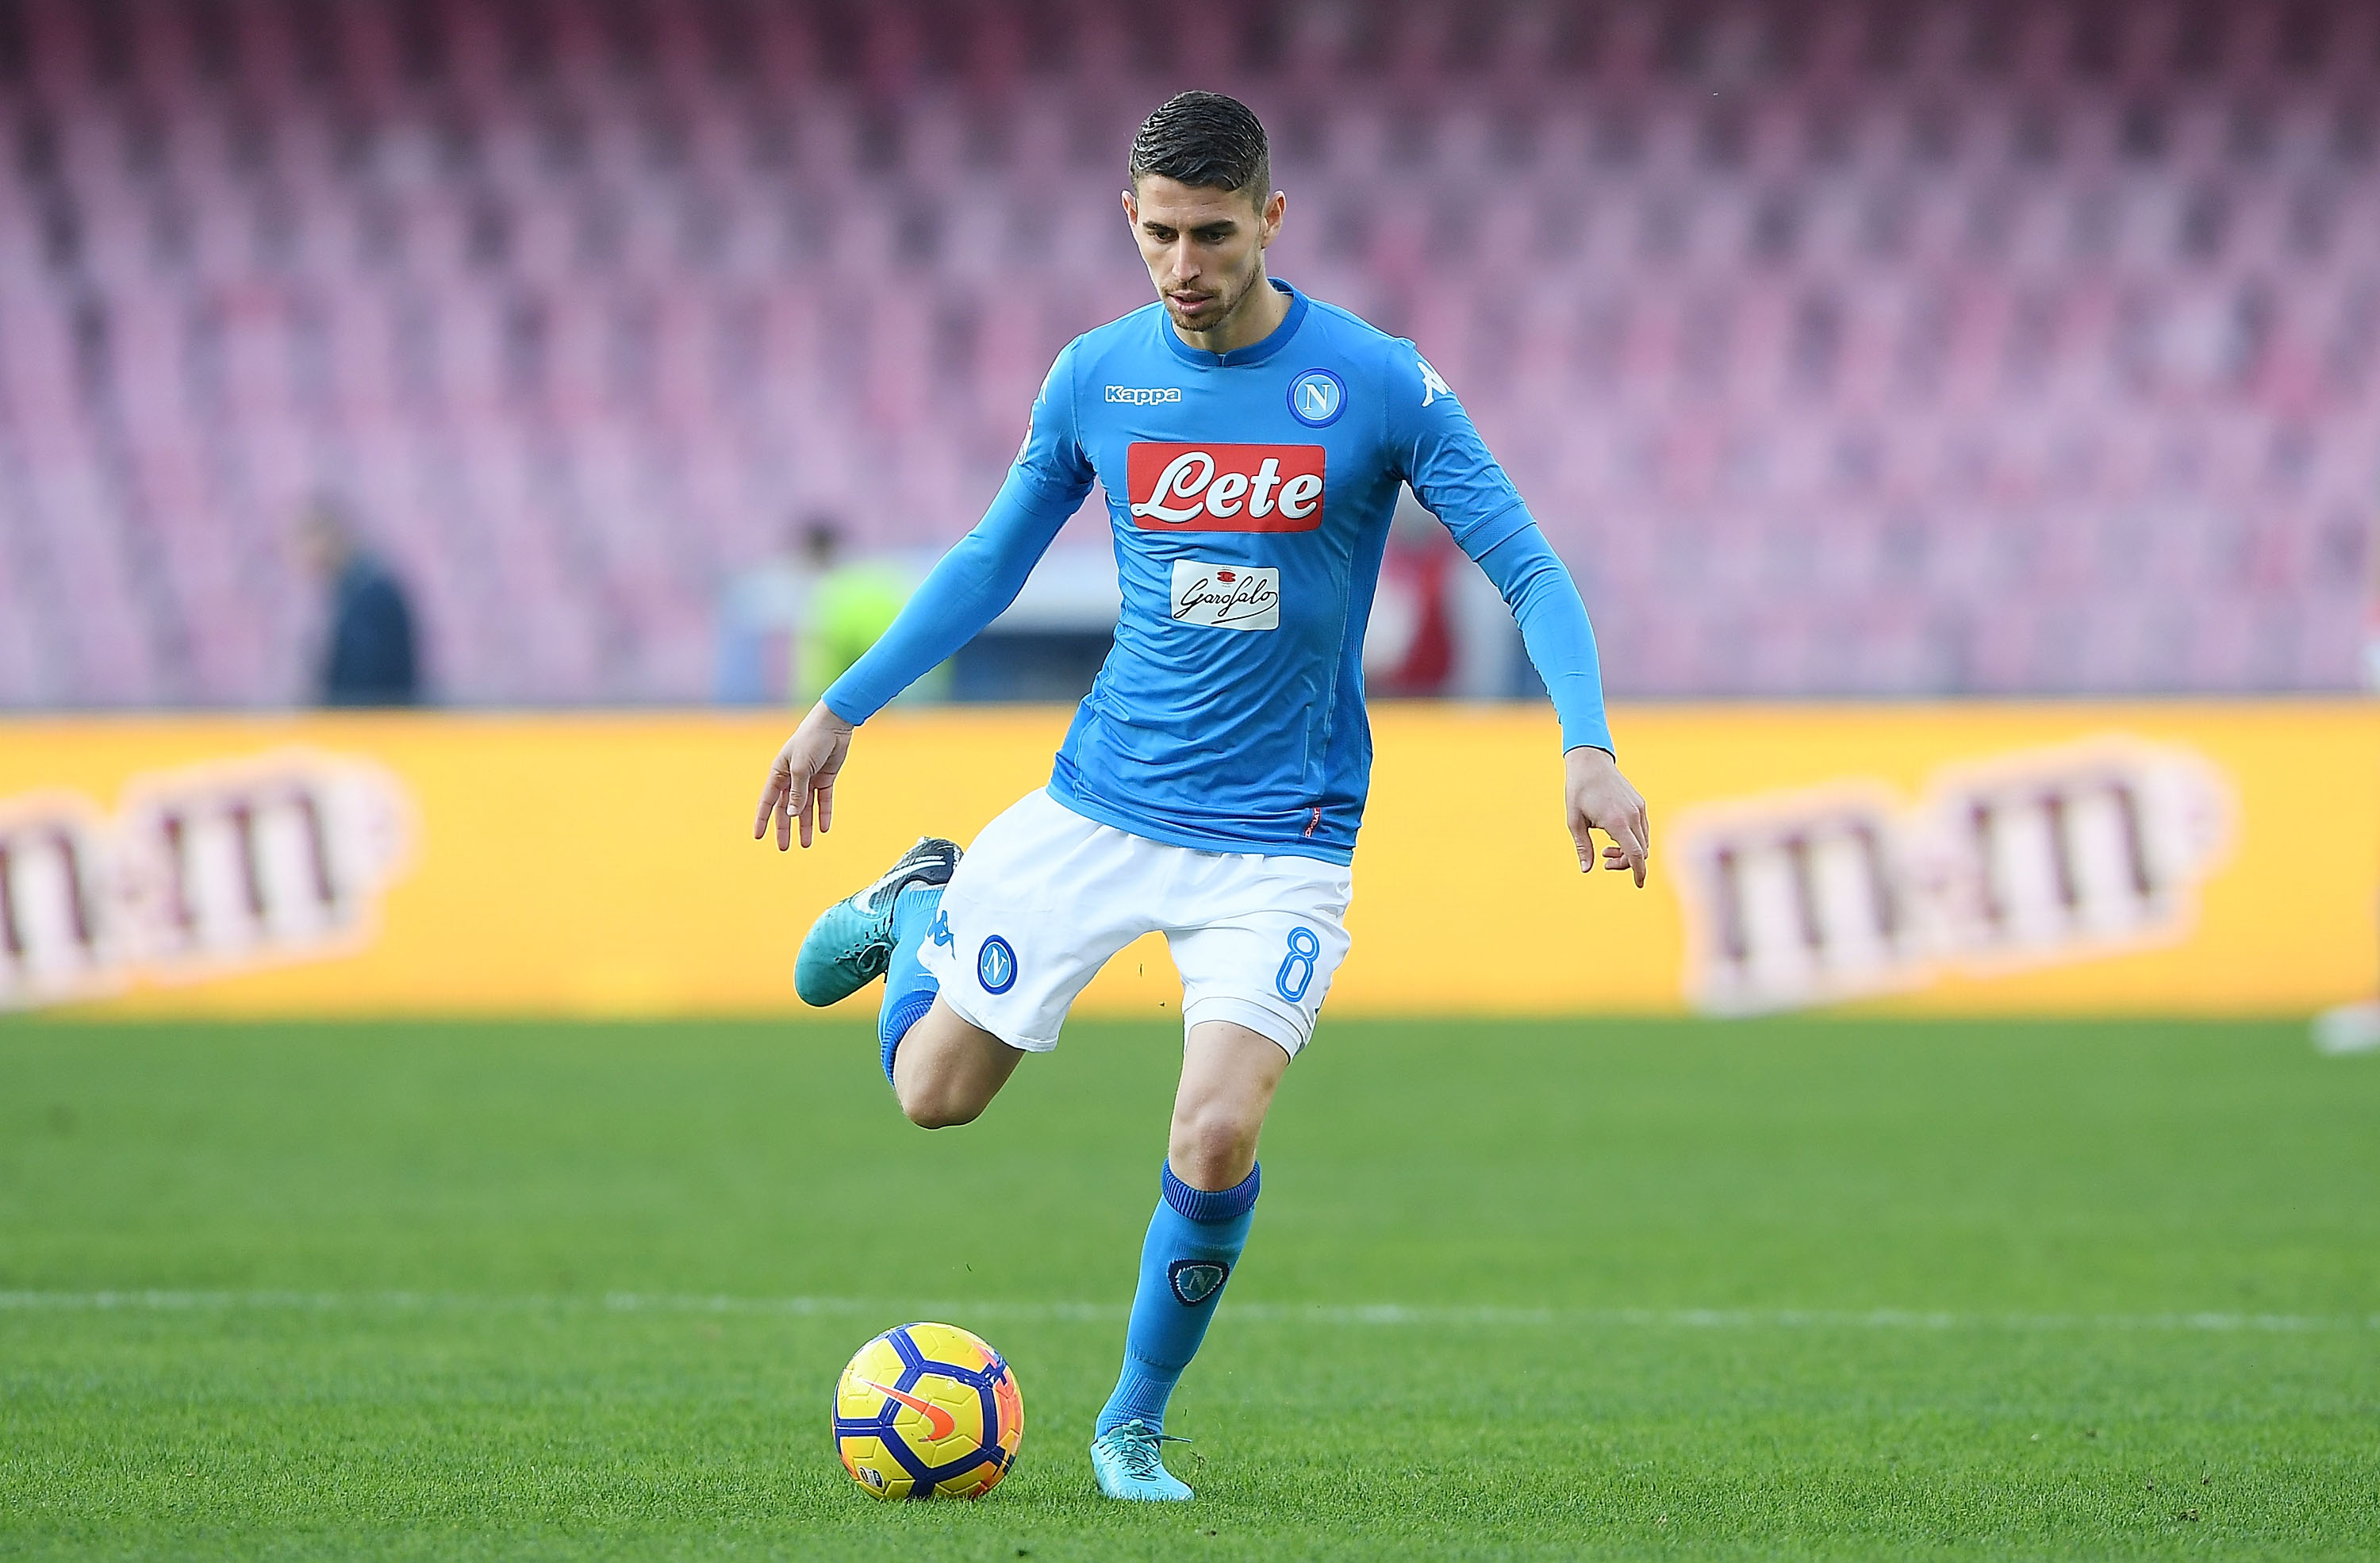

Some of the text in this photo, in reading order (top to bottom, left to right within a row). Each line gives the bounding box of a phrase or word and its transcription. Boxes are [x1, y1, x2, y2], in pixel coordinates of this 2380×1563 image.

[1105, 385, 1181, 405] Kappa
[1303, 383, 1331, 411] N
[1130, 451, 1323, 524] Lete
[1173, 575, 1278, 624] Garofalo
[984, 947, 1008, 981] N
[1276, 927, 1320, 1002] 8
